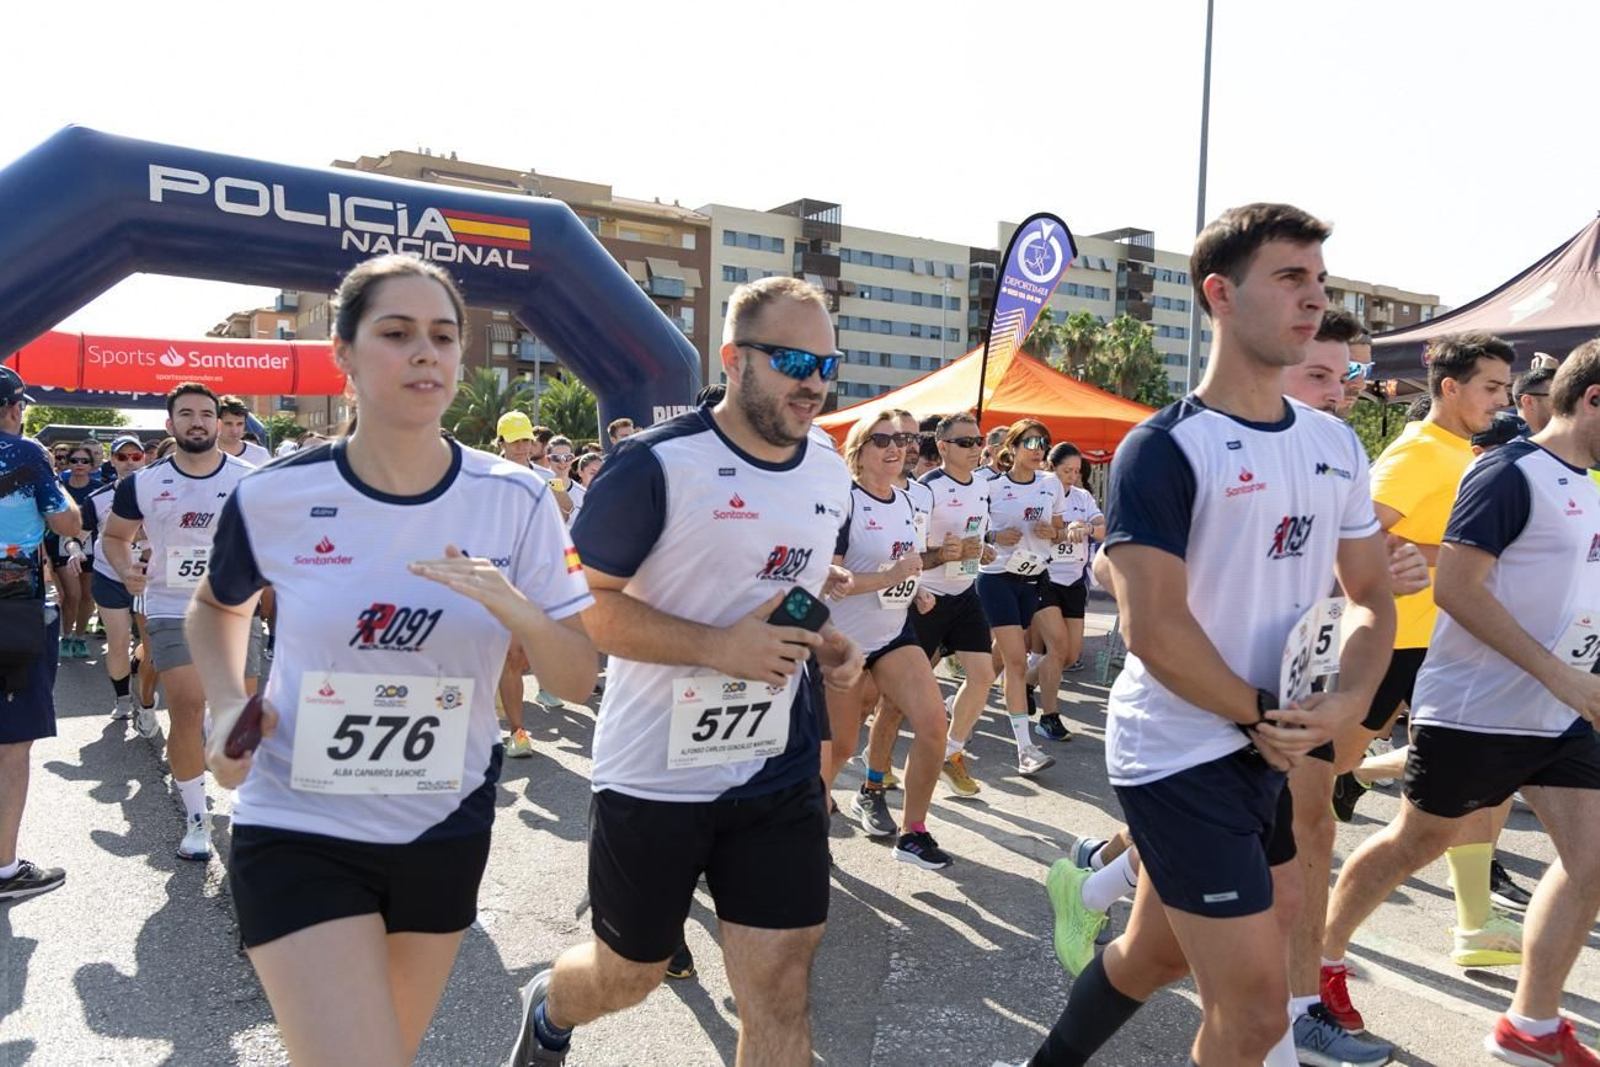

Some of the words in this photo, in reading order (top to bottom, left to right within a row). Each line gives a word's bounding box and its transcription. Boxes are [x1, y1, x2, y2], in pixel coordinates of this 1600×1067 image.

[341, 230, 530, 271] NACIONAL
[88, 345, 155, 367] Sports
[188, 351, 290, 370] Santander
[713, 510, 759, 520] Santander
[1058, 544, 1074, 555] 93
[178, 560, 207, 577] 55
[293, 555, 353, 566] Santander
[1018, 562, 1037, 575] 91
[1316, 624, 1333, 655] 5
[691, 701, 772, 742] 577
[326, 714, 441, 762] 576
[333, 768, 352, 777] ALBA
